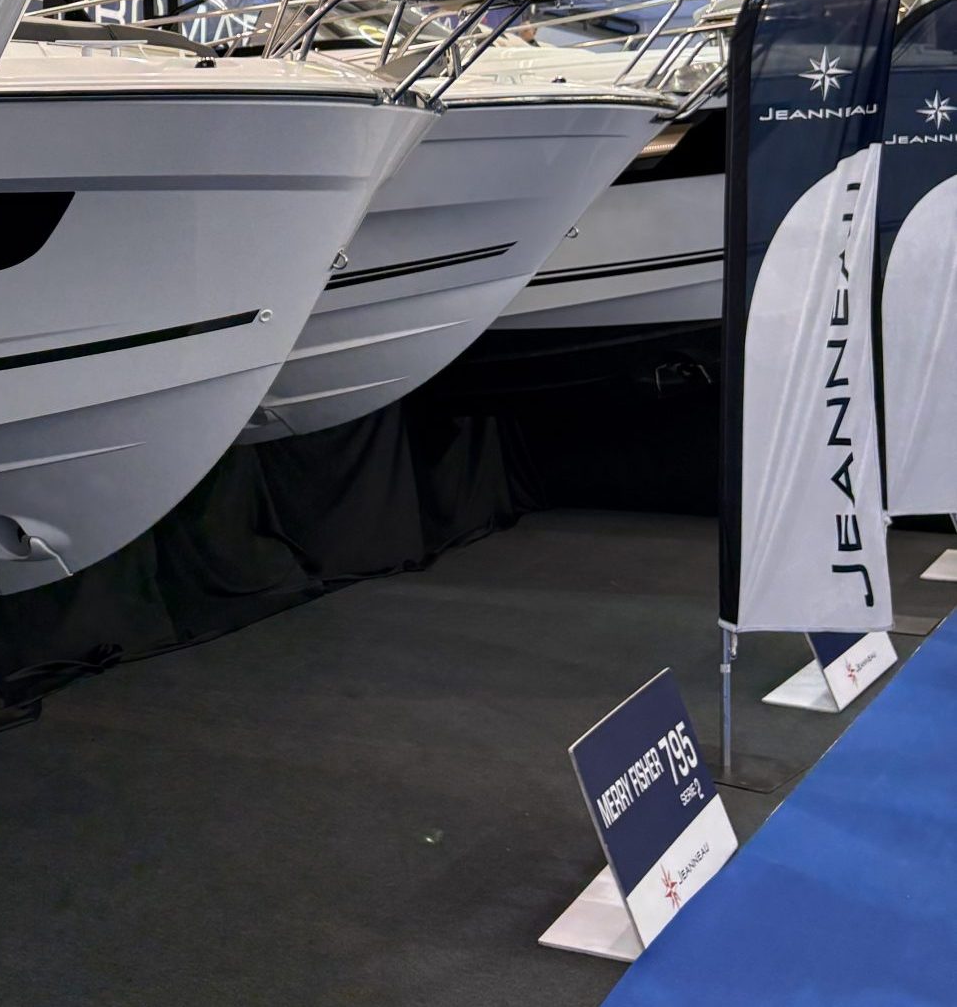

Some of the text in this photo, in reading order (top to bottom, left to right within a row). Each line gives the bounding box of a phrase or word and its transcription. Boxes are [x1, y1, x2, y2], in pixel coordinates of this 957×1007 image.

[885, 134, 957, 145] JEANN
[596, 720, 698, 829] MERRY FISHER 795
[679, 777, 705, 807] SERIE 2
[677, 841, 710, 885] JEANNEAU
